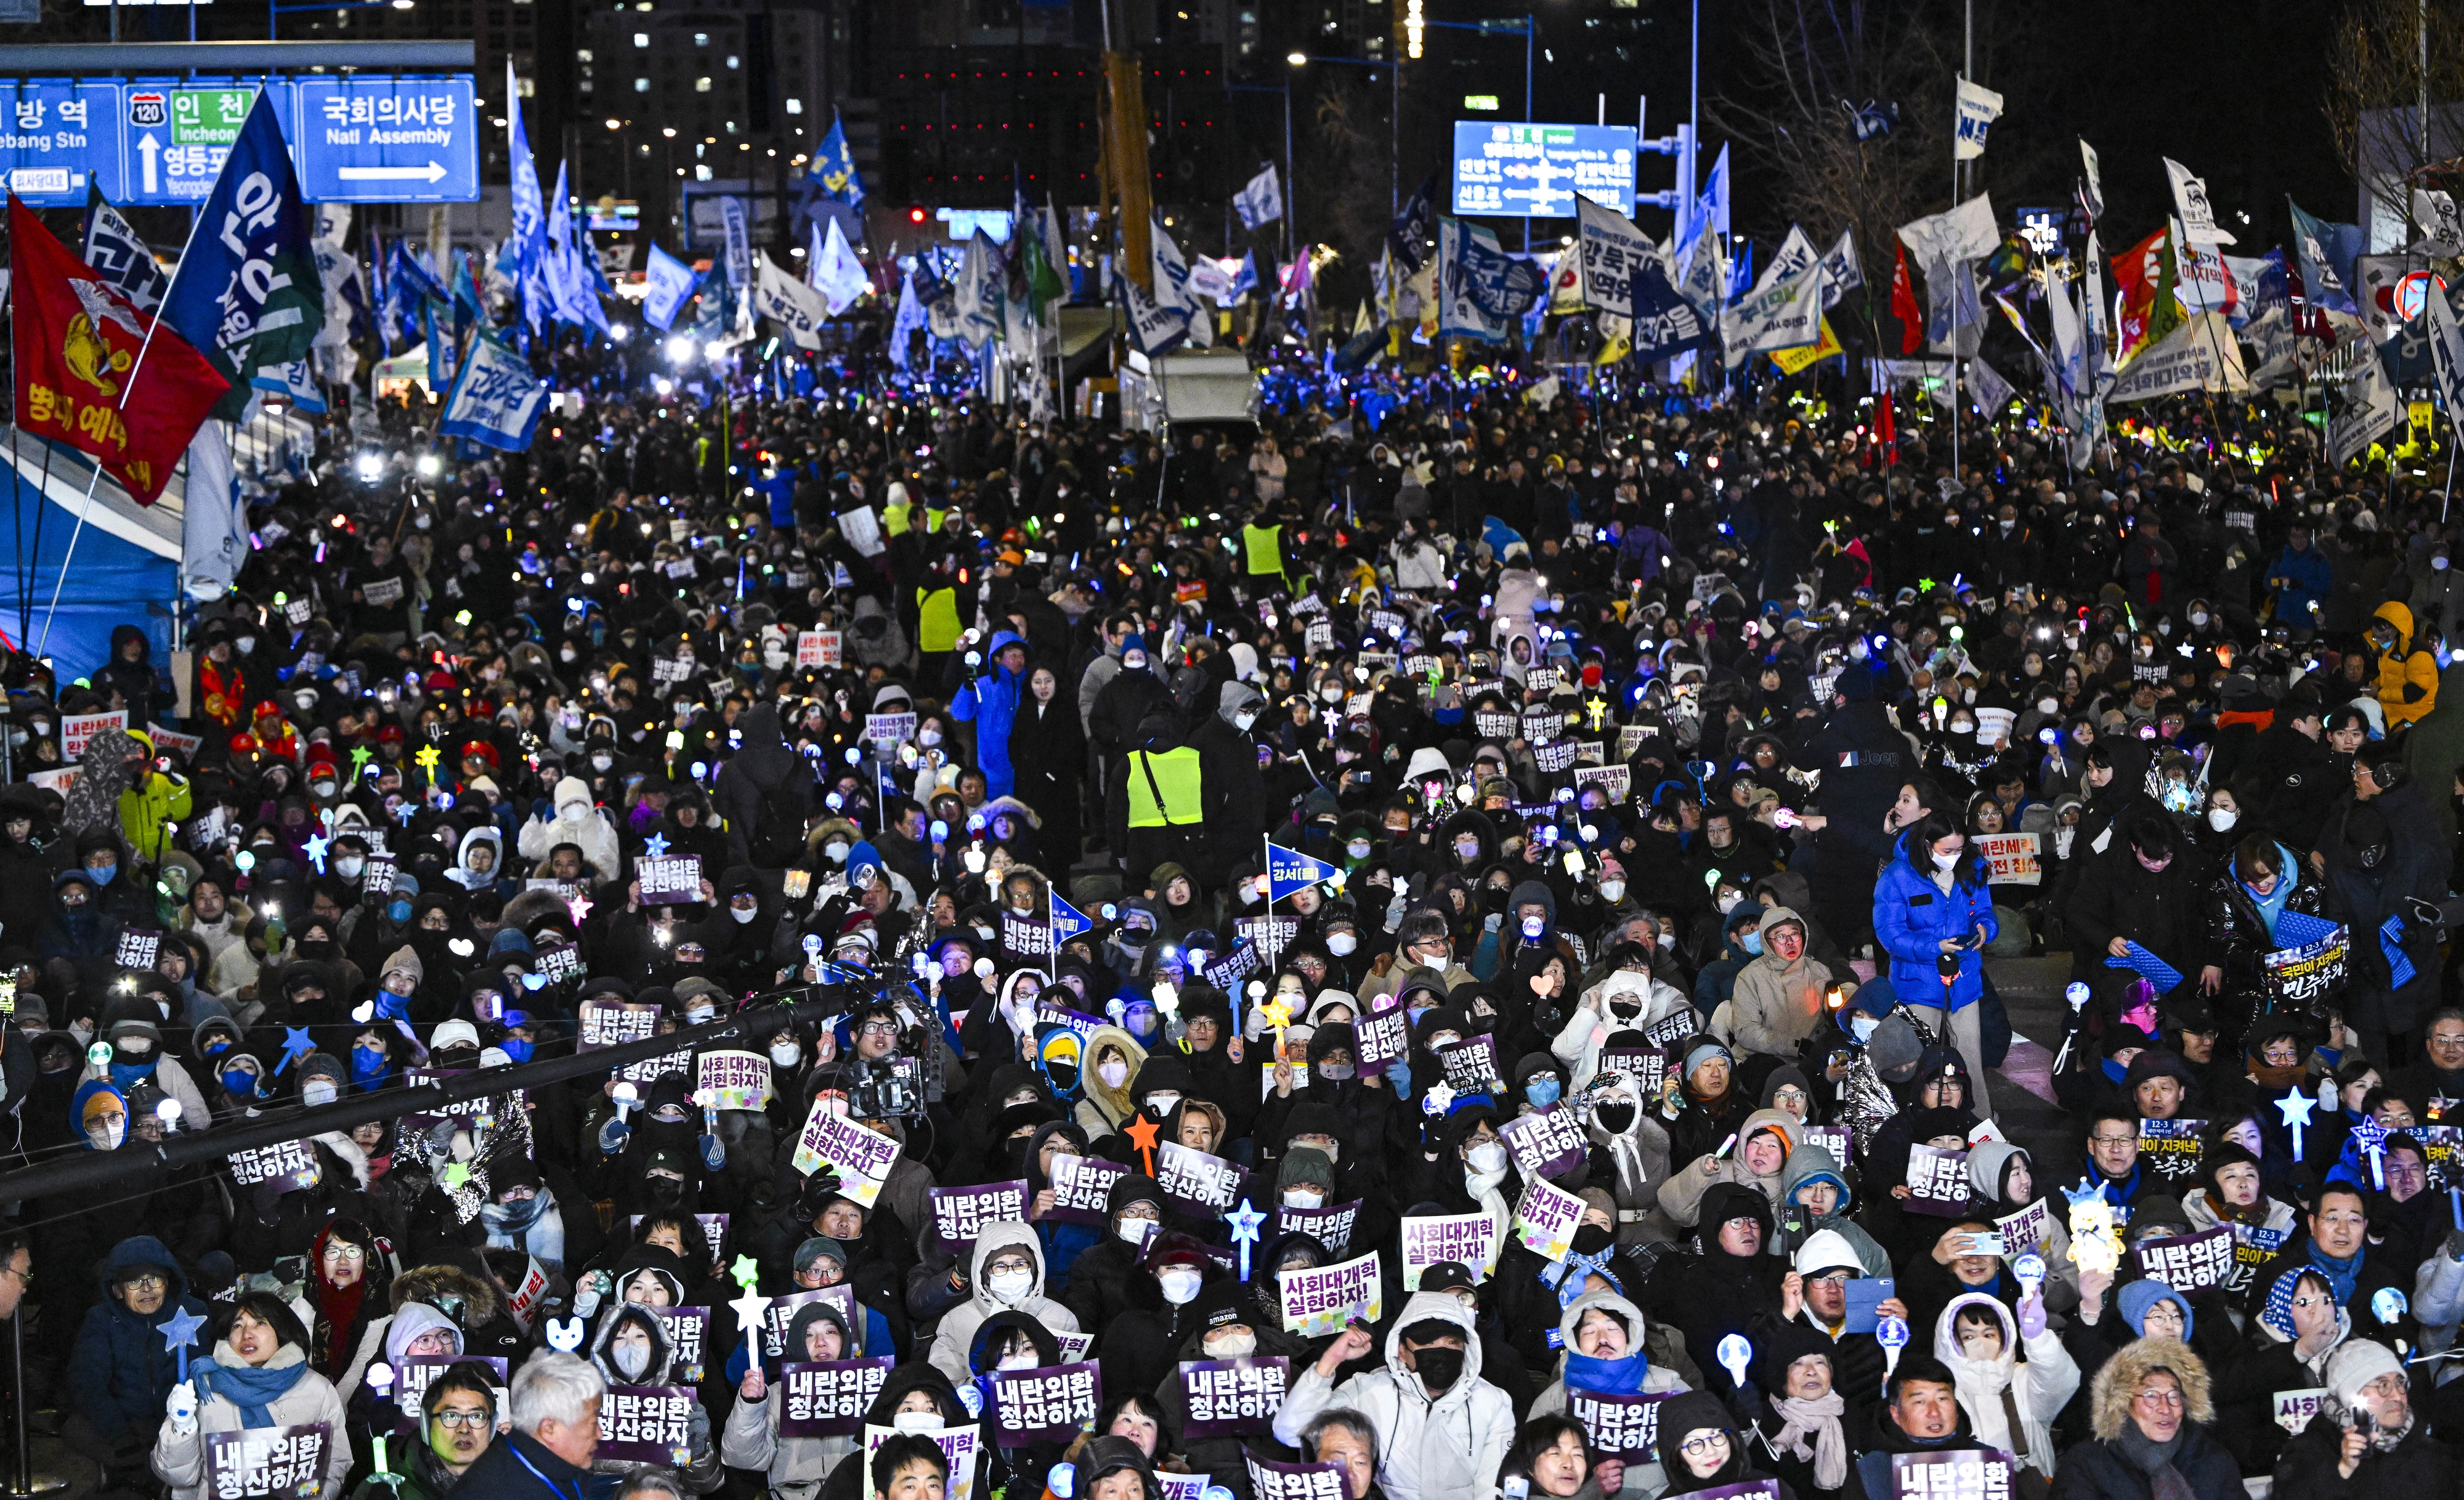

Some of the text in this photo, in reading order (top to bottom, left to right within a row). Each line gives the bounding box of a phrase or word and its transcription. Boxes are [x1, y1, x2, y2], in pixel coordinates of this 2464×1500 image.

[16, 99, 87, 129] 방역
[136, 104, 160, 122] 120
[175, 95, 246, 123] 인천
[323, 96, 456, 124] 국회의사당
[56, 131, 87, 148] Stn
[326, 128, 451, 148] Natl Assembly
[1522, 715, 1563, 729] 내란외환
[1534, 742, 1576, 760] 내란외환
[1860, 750, 1900, 768] Jeep
[1578, 767, 1628, 781] 사회대개혁
[639, 859, 700, 877] 내란외환
[1272, 867, 1319, 882] 강서(을)
[640, 874, 700, 894] 청산하자
[1004, 918, 1052, 938] 내란외
[1238, 922, 1297, 939] 내란외환
[2281, 946, 2343, 978] 국민이 지켜낸
[585, 1007, 656, 1029] 내란외환
[1358, 1010, 1405, 1043] 내란외환
[700, 1056, 769, 1077] 사회대개혁
[1601, 1055, 1664, 1072] 내란외환
[700, 1072, 763, 1090] 실현하자!
[810, 1109, 893, 1164] 사회대개혁
[2160, 1138, 2197, 1154] 지켜낸
[803, 1126, 873, 1176] 실현하자!
[232, 1146, 307, 1186] 청산하자
[1162, 1150, 1240, 1194] 내란외환
[934, 1188, 1023, 1217] 내란외환
[1052, 1182, 1109, 1214] 청산하
[1158, 1171, 1234, 1209] 청산하자
[1911, 1178, 1971, 1202] 청산하
[1280, 1207, 1356, 1234] 내란외환
[1407, 1218, 1493, 1244] 사회대개혁
[1407, 1238, 1485, 1264] 실현하자!
[2140, 1232, 2233, 1275] 내란외환
[1285, 1260, 1377, 1297] 사회대개혁
[1286, 1283, 1369, 1315] 실현하자!
[1209, 1312, 1238, 1326] amazon
[789, 1366, 886, 1395] 내란외환
[995, 1372, 1093, 1405] 내란외환
[1188, 1368, 1286, 1398] 내란외환
[997, 1400, 1096, 1430] 청산하자
[215, 1432, 323, 1471] 내란외환
[216, 1460, 318, 1500] 청산하자
[1247, 1457, 1342, 1498] 내란외환
[1901, 1461, 2009, 1492] 내란외환
